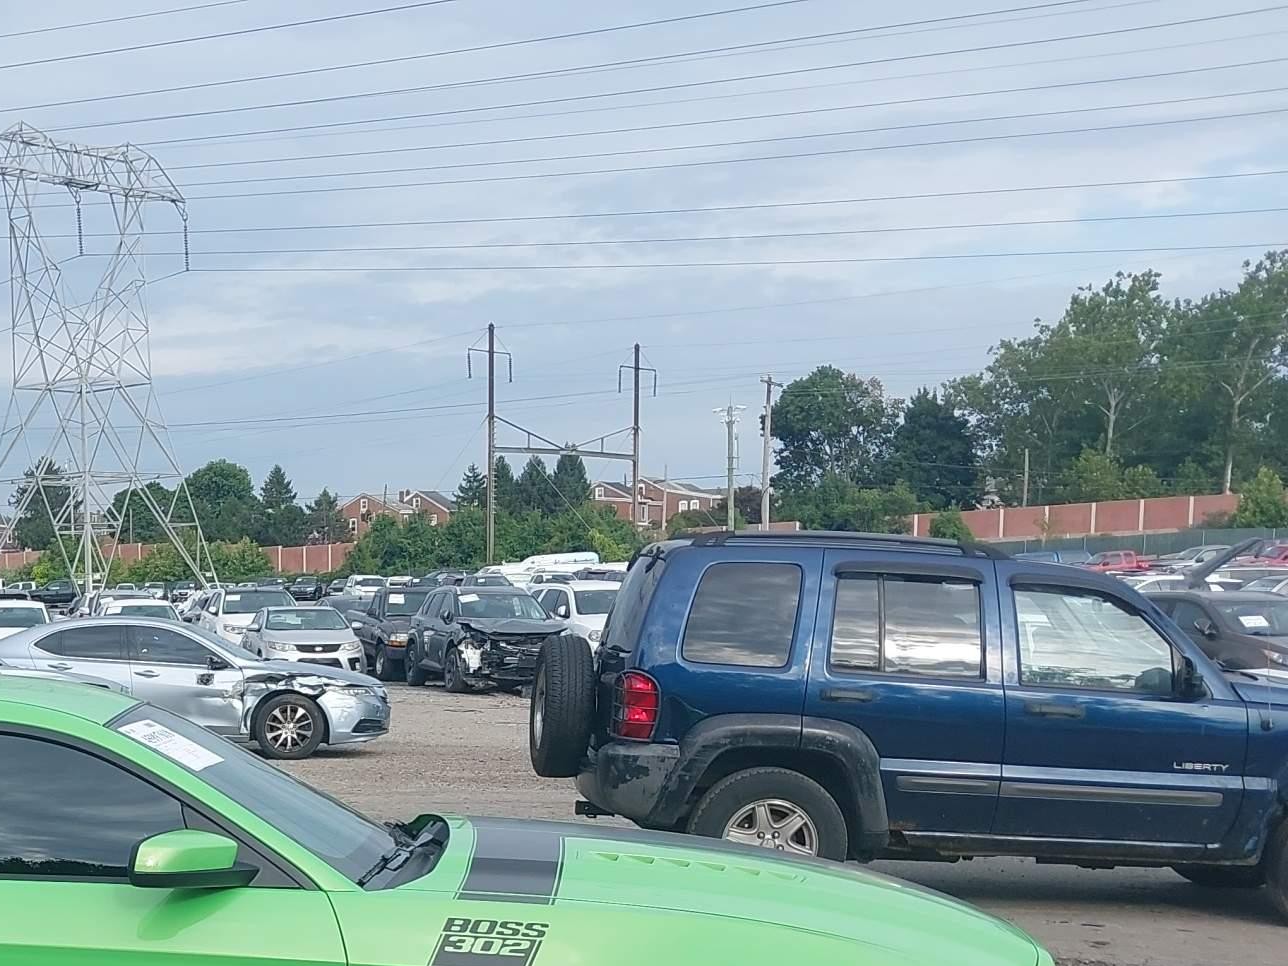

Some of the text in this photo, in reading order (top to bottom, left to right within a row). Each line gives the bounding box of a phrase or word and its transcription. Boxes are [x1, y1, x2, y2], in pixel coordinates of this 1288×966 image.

[1173, 761, 1229, 771] LIBERTY
[442, 917, 550, 938] BOSS
[444, 936, 531, 956] 302
